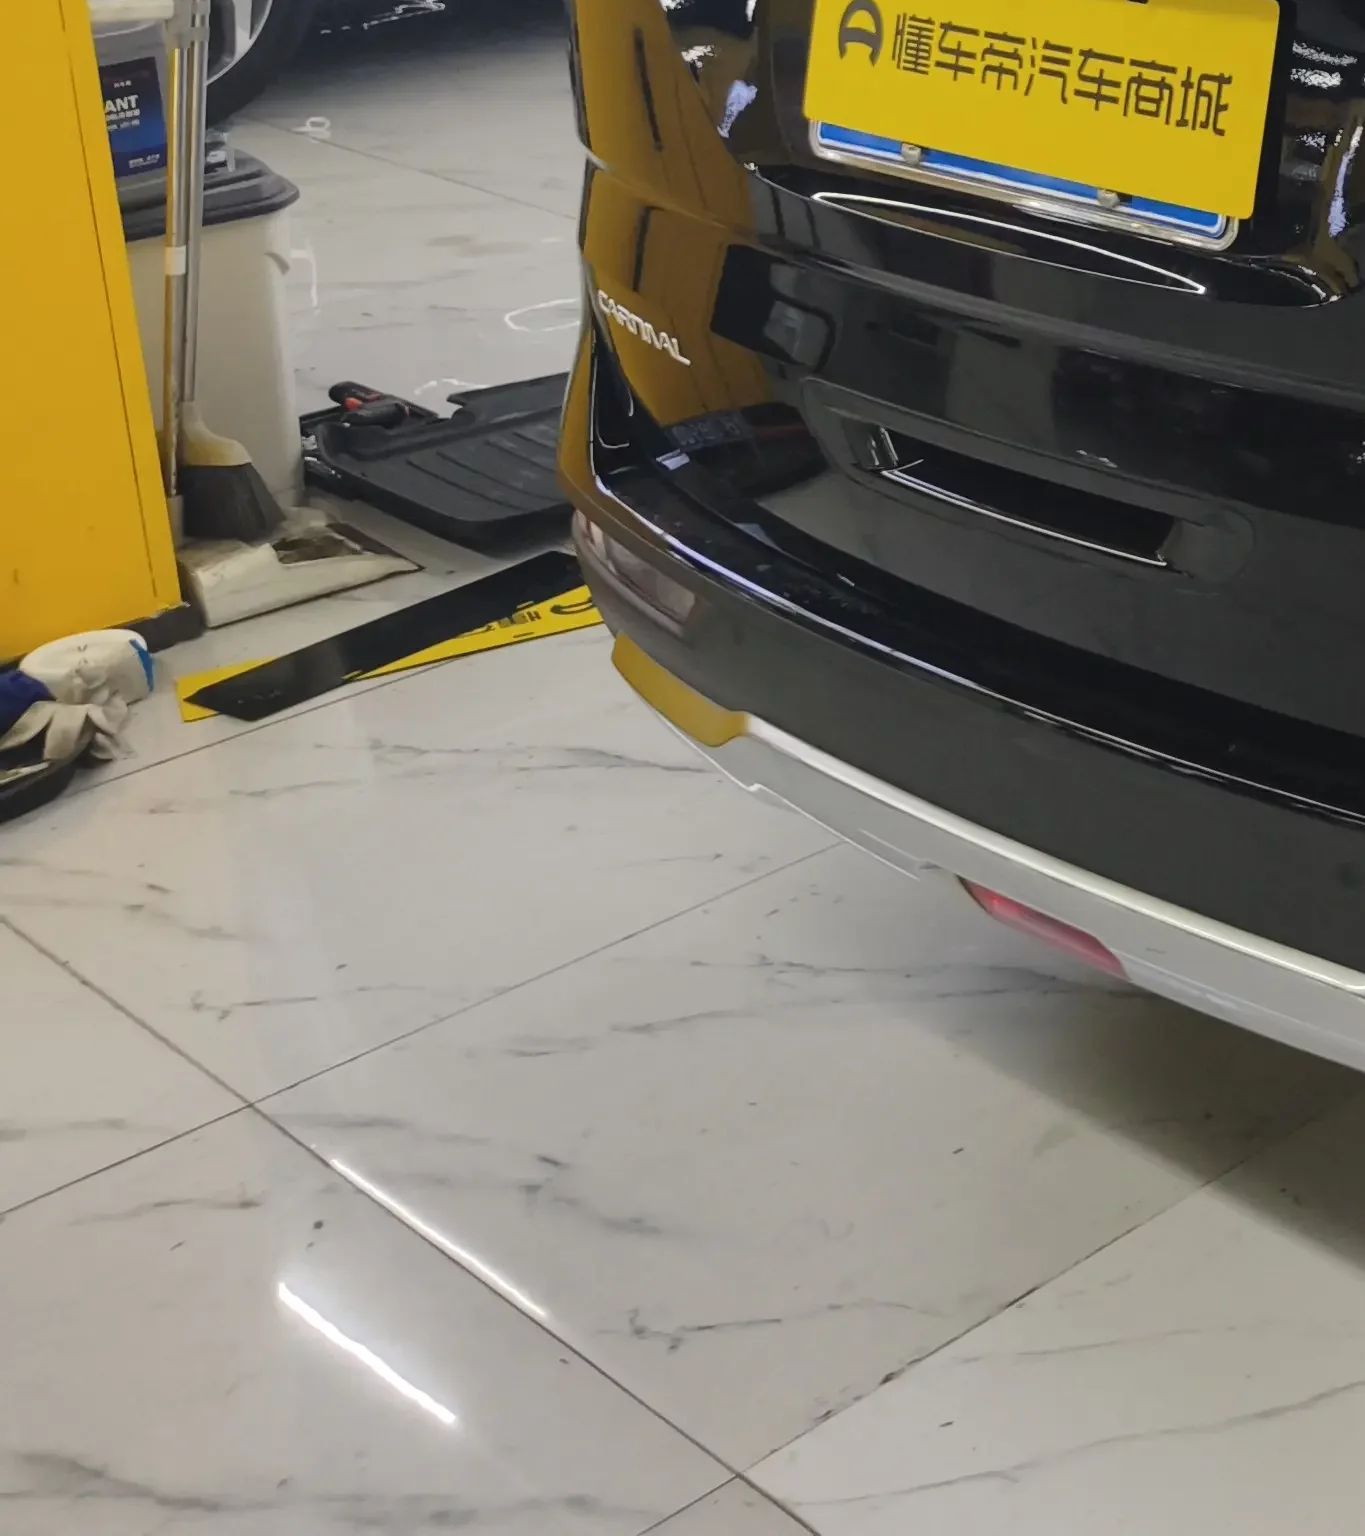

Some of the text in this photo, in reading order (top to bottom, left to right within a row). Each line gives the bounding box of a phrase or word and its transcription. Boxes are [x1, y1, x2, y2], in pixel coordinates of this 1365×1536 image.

[890, 12, 1233, 137] 懂车帝汽车商城
